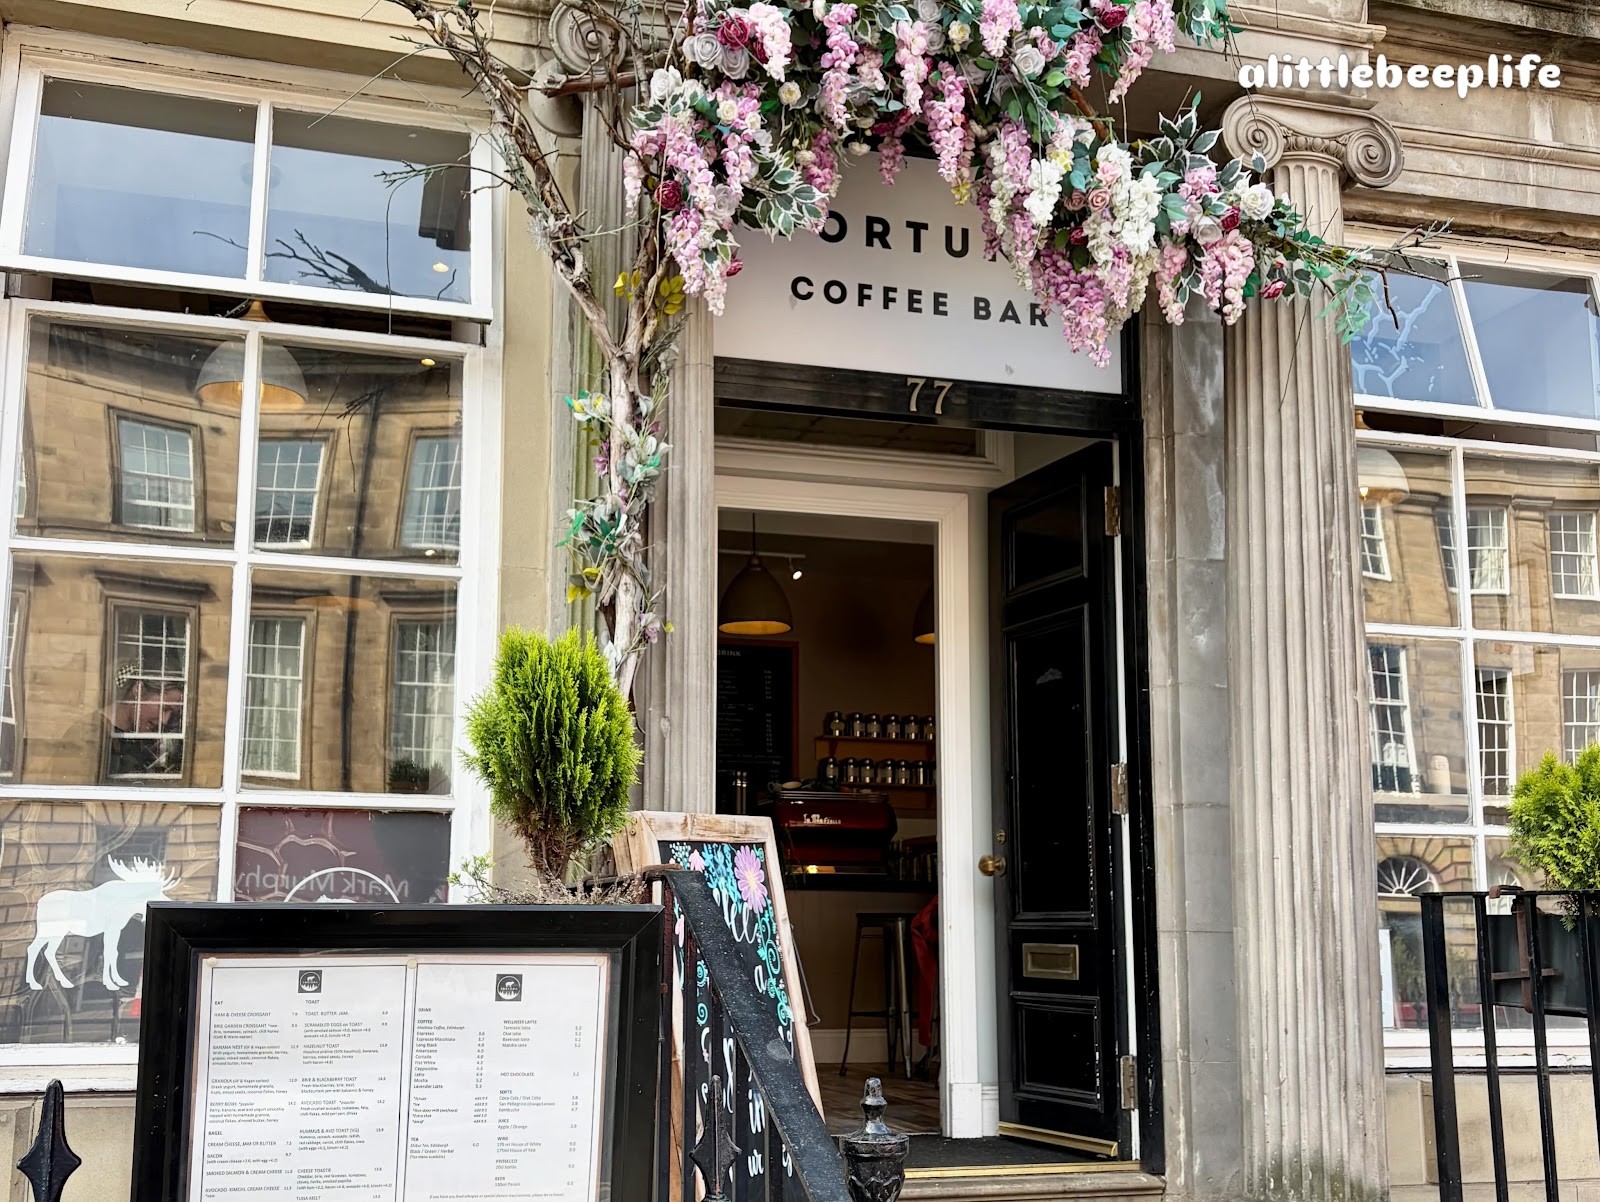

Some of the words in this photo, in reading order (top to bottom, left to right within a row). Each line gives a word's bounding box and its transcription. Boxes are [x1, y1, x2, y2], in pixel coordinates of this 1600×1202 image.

[790, 276, 949, 317] COFFEE
[974, 296, 1050, 328] BAR
[906, 377, 954, 415] 77
